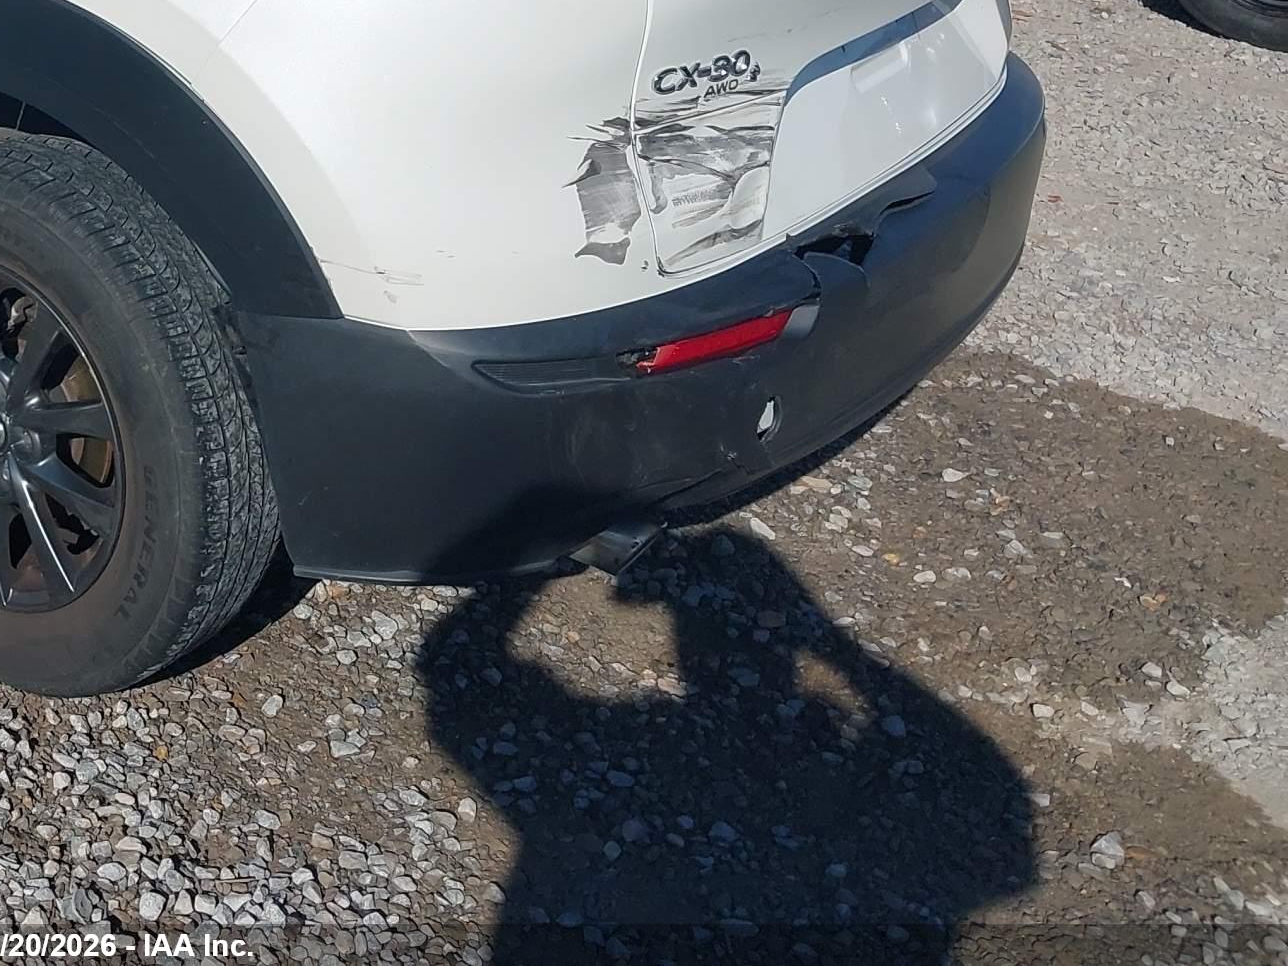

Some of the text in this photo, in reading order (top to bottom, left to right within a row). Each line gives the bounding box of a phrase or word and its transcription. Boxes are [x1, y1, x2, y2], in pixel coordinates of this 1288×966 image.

[653, 49, 751, 94] CX-30
[703, 79, 739, 98] AWD
[114, 464, 159, 619] GENERAL
